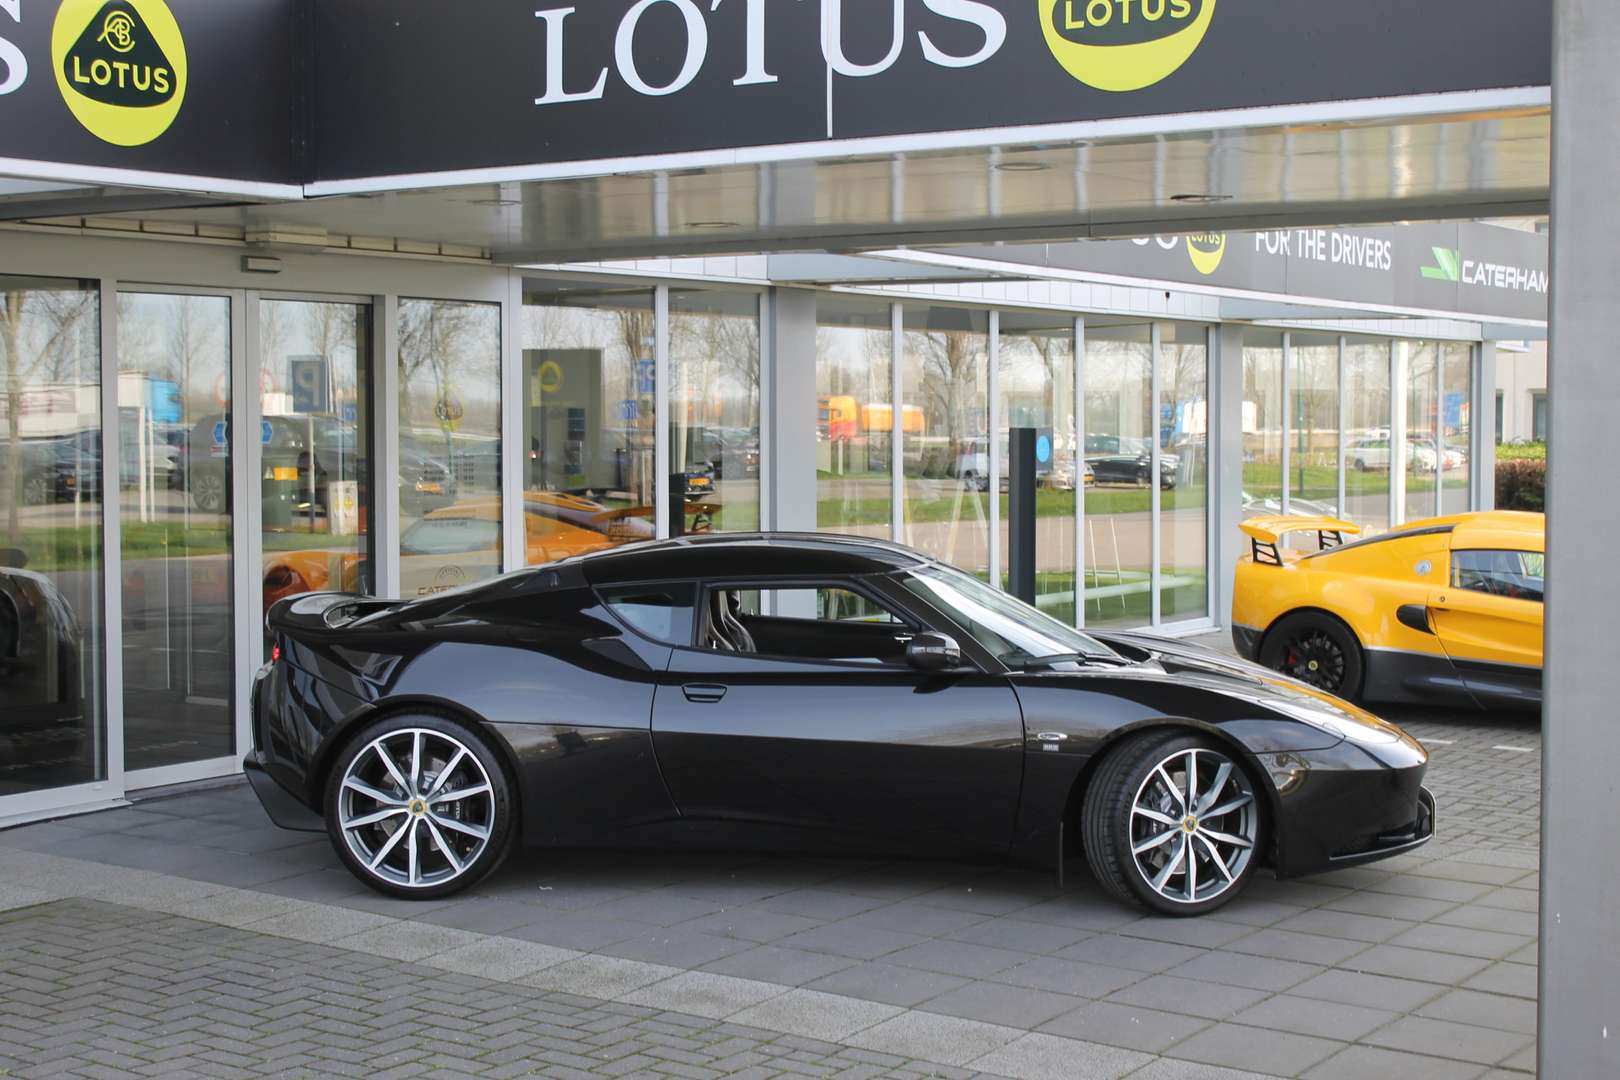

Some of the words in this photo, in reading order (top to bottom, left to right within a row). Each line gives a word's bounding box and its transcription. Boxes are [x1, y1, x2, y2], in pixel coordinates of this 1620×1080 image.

[1065, 0, 1193, 30] LOTUS
[535, 0, 1007, 105] LOTUS
[72, 55, 171, 94] LOTUS
[1255, 231, 1291, 256] FOR
[1296, 229, 1327, 261] THE
[1331, 231, 1392, 271] DRIVERS
